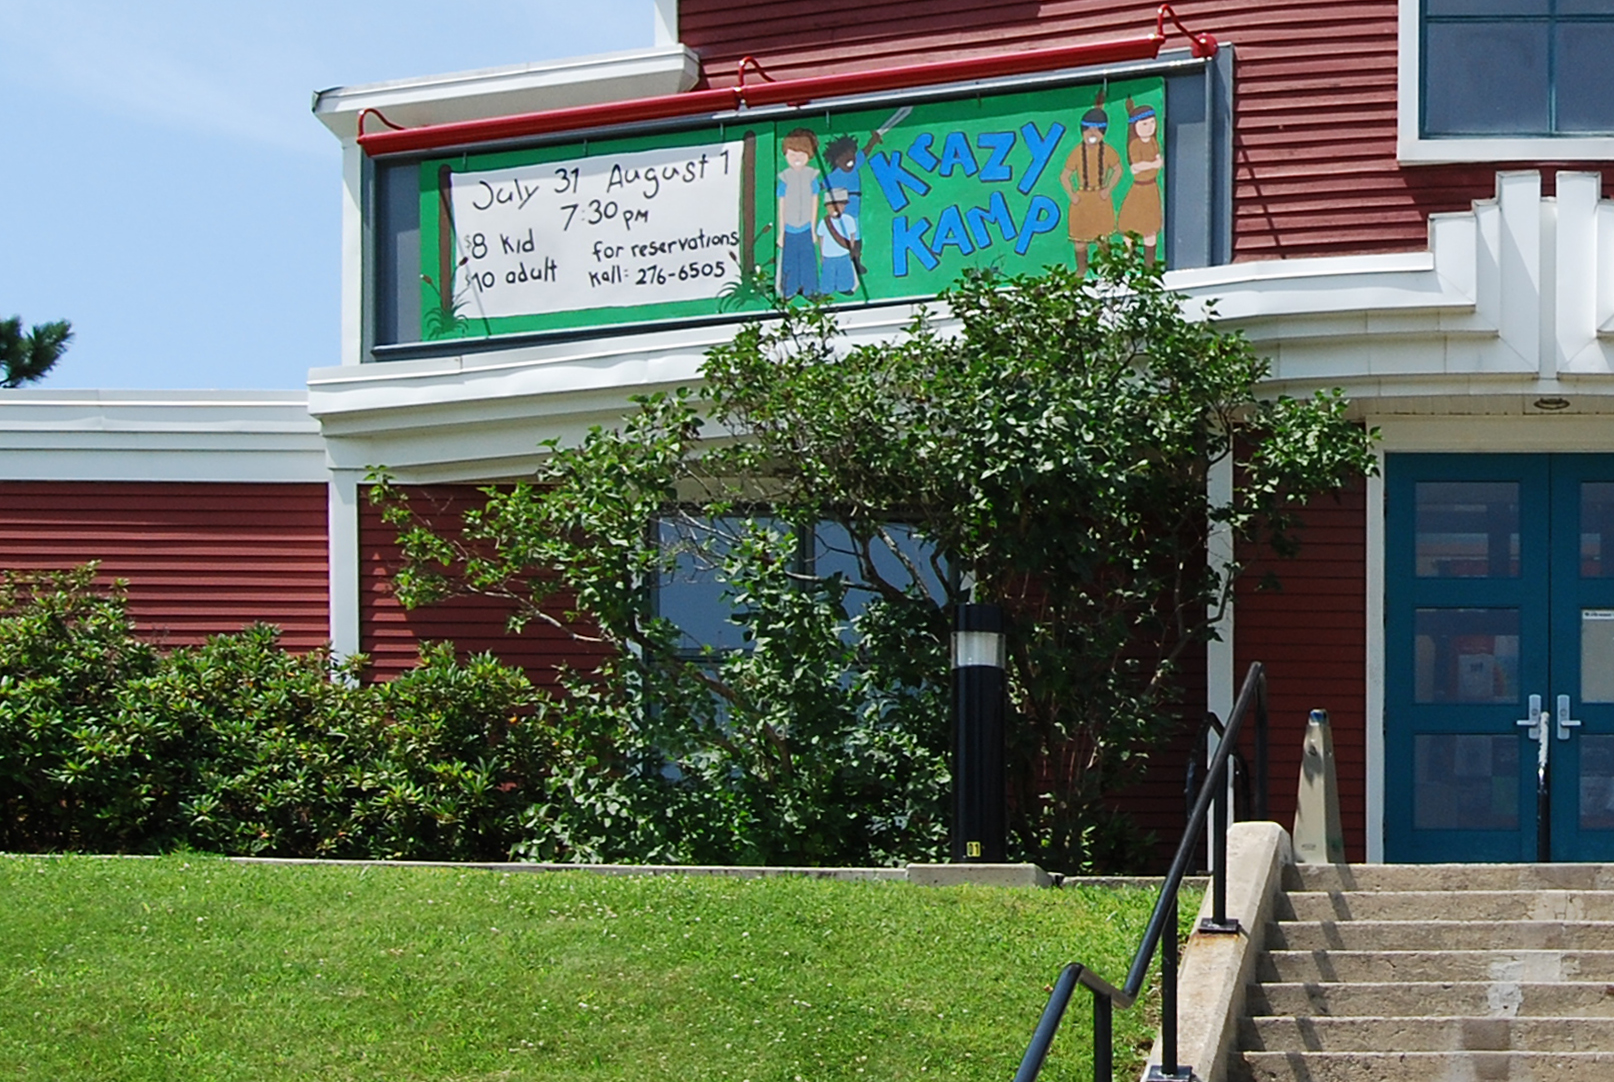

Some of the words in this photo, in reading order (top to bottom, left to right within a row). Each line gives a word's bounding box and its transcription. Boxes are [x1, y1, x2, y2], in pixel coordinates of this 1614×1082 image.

[473, 178, 539, 210] July
[554, 167, 579, 193] 31
[606, 153, 709, 199] August
[720, 149, 729, 175] 1
[560, 199, 618, 231] 7:30
[593, 241, 624, 262] for
[631, 228, 740, 259] reservations
[892, 191, 1061, 277] KAMP
[505, 256, 557, 284] adult
[635, 261, 725, 285] 276-6505
